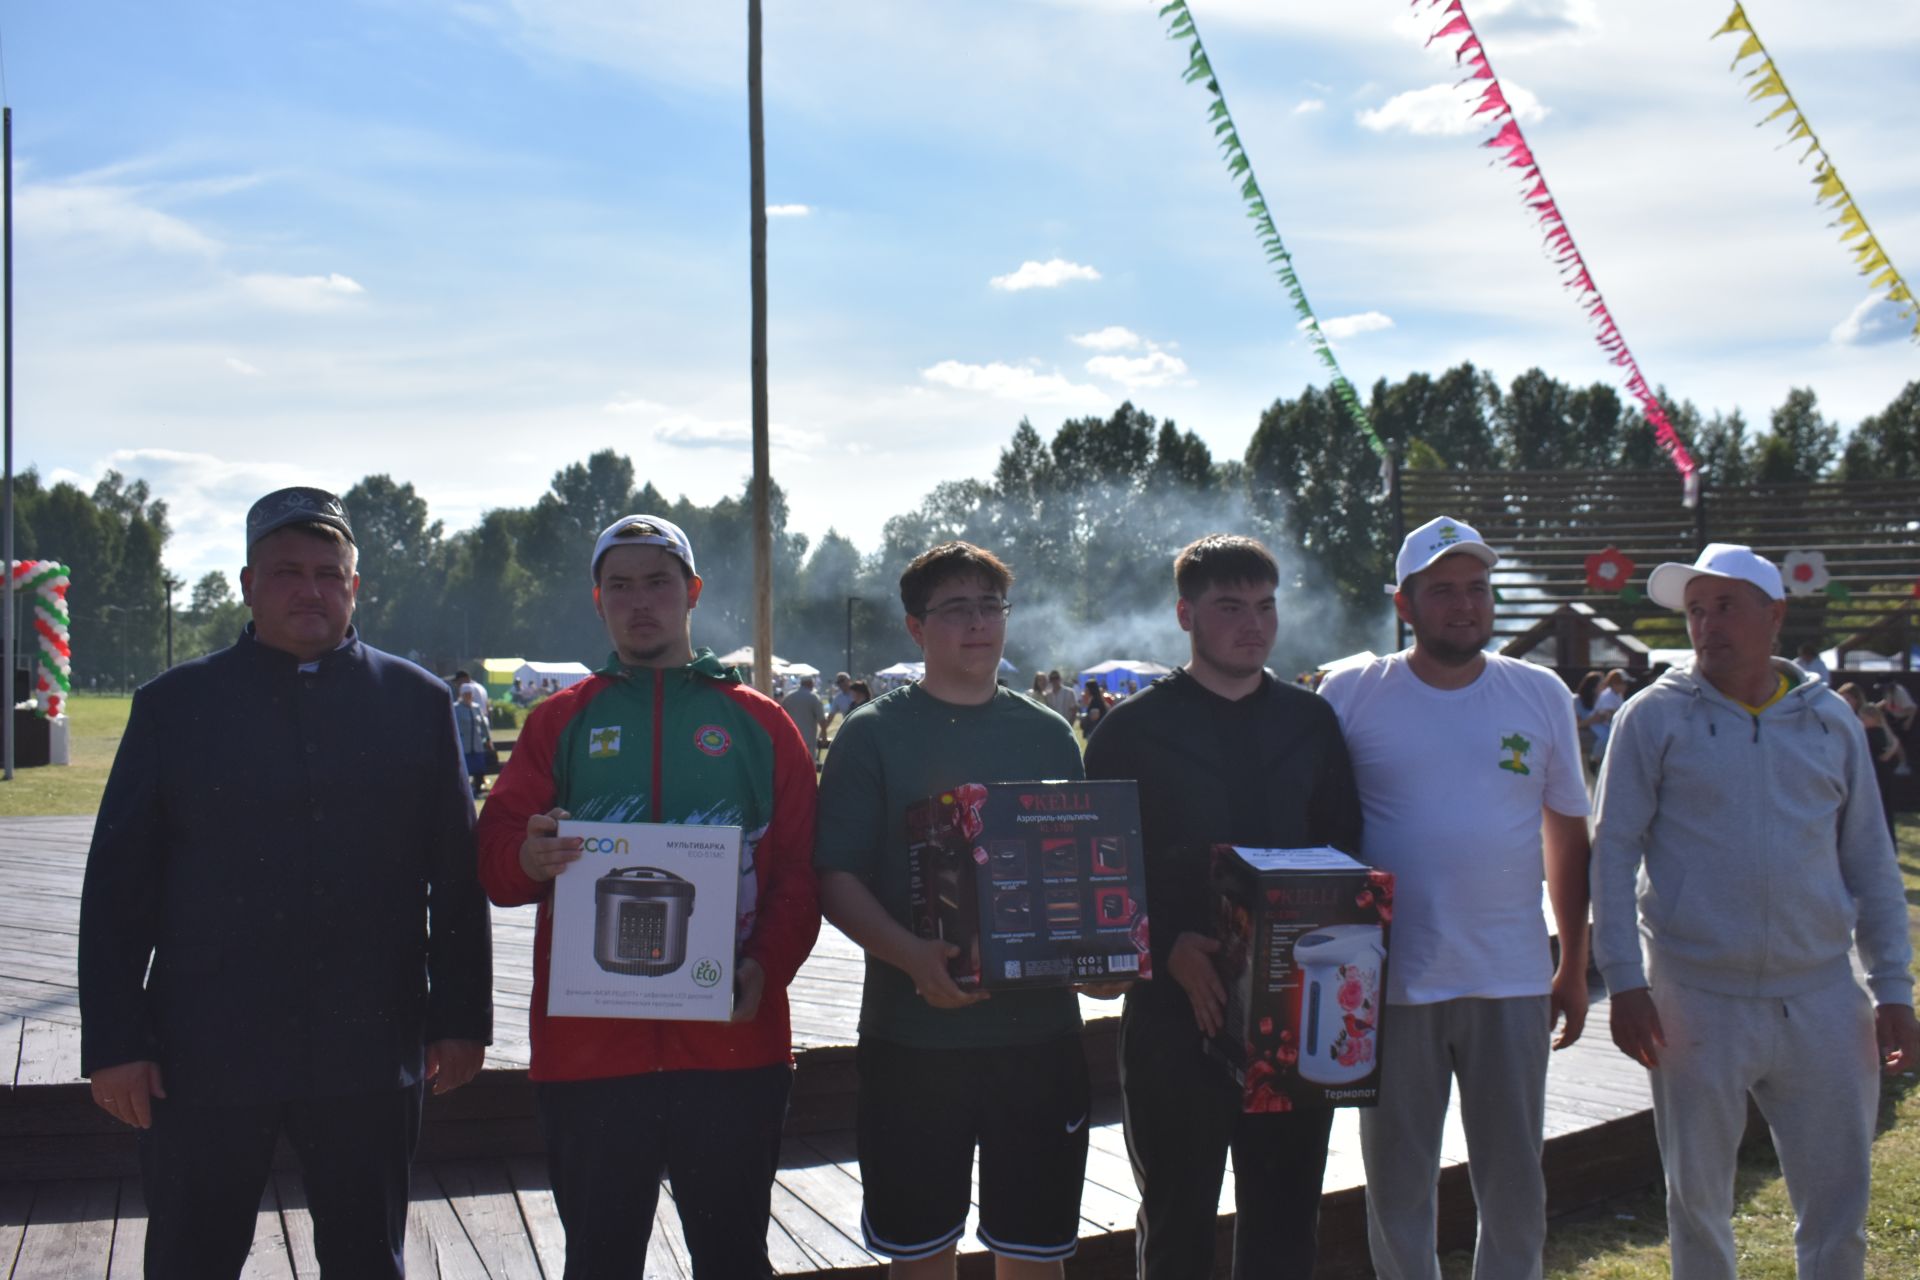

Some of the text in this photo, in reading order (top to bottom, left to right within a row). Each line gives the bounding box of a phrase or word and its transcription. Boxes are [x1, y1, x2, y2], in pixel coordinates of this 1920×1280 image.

[666, 841, 726, 850] МУЛЬТИВАРКА
[696, 967, 717, 982] ECO
[1324, 1089, 1377, 1101] Термопот
